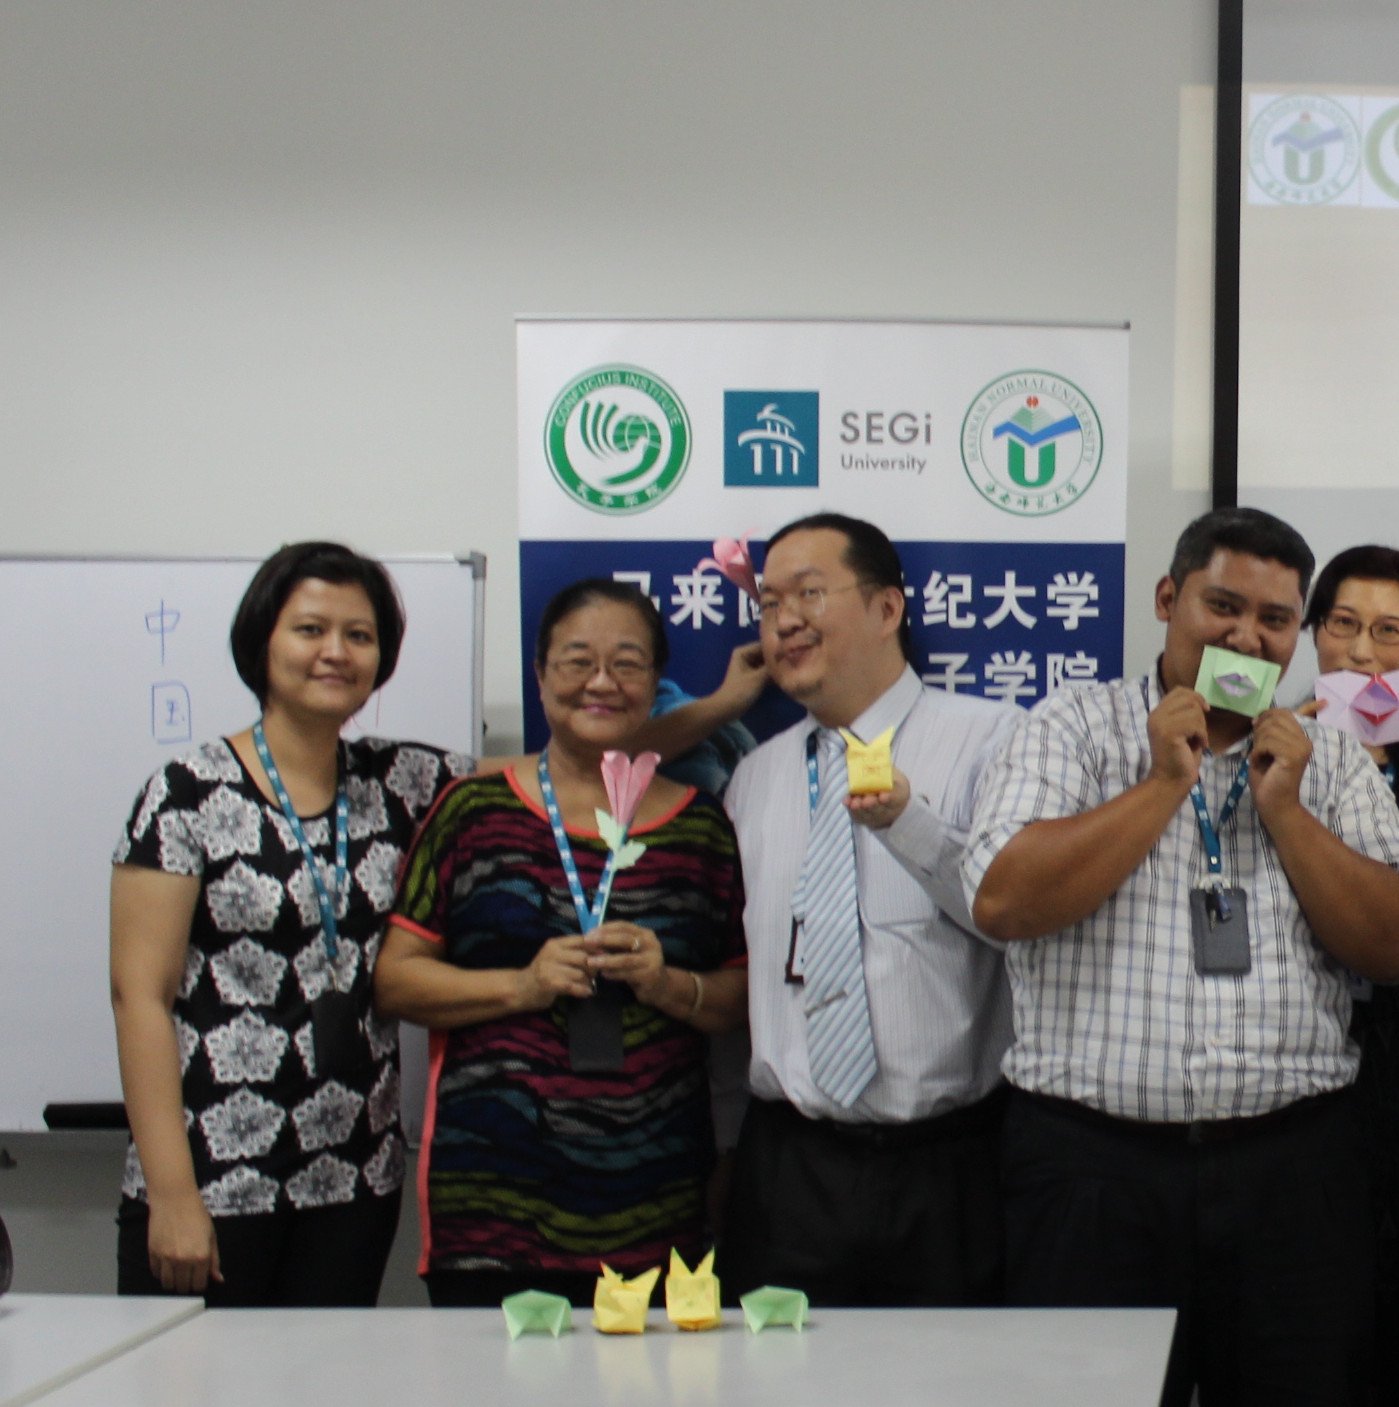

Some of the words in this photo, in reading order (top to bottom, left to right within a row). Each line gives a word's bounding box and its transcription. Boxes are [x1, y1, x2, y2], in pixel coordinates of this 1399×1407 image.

[555, 372, 621, 427] CONFUCIUS
[625, 373, 682, 427] INSTITUTE
[840, 411, 932, 445] SEGi
[841, 453, 927, 475] University
